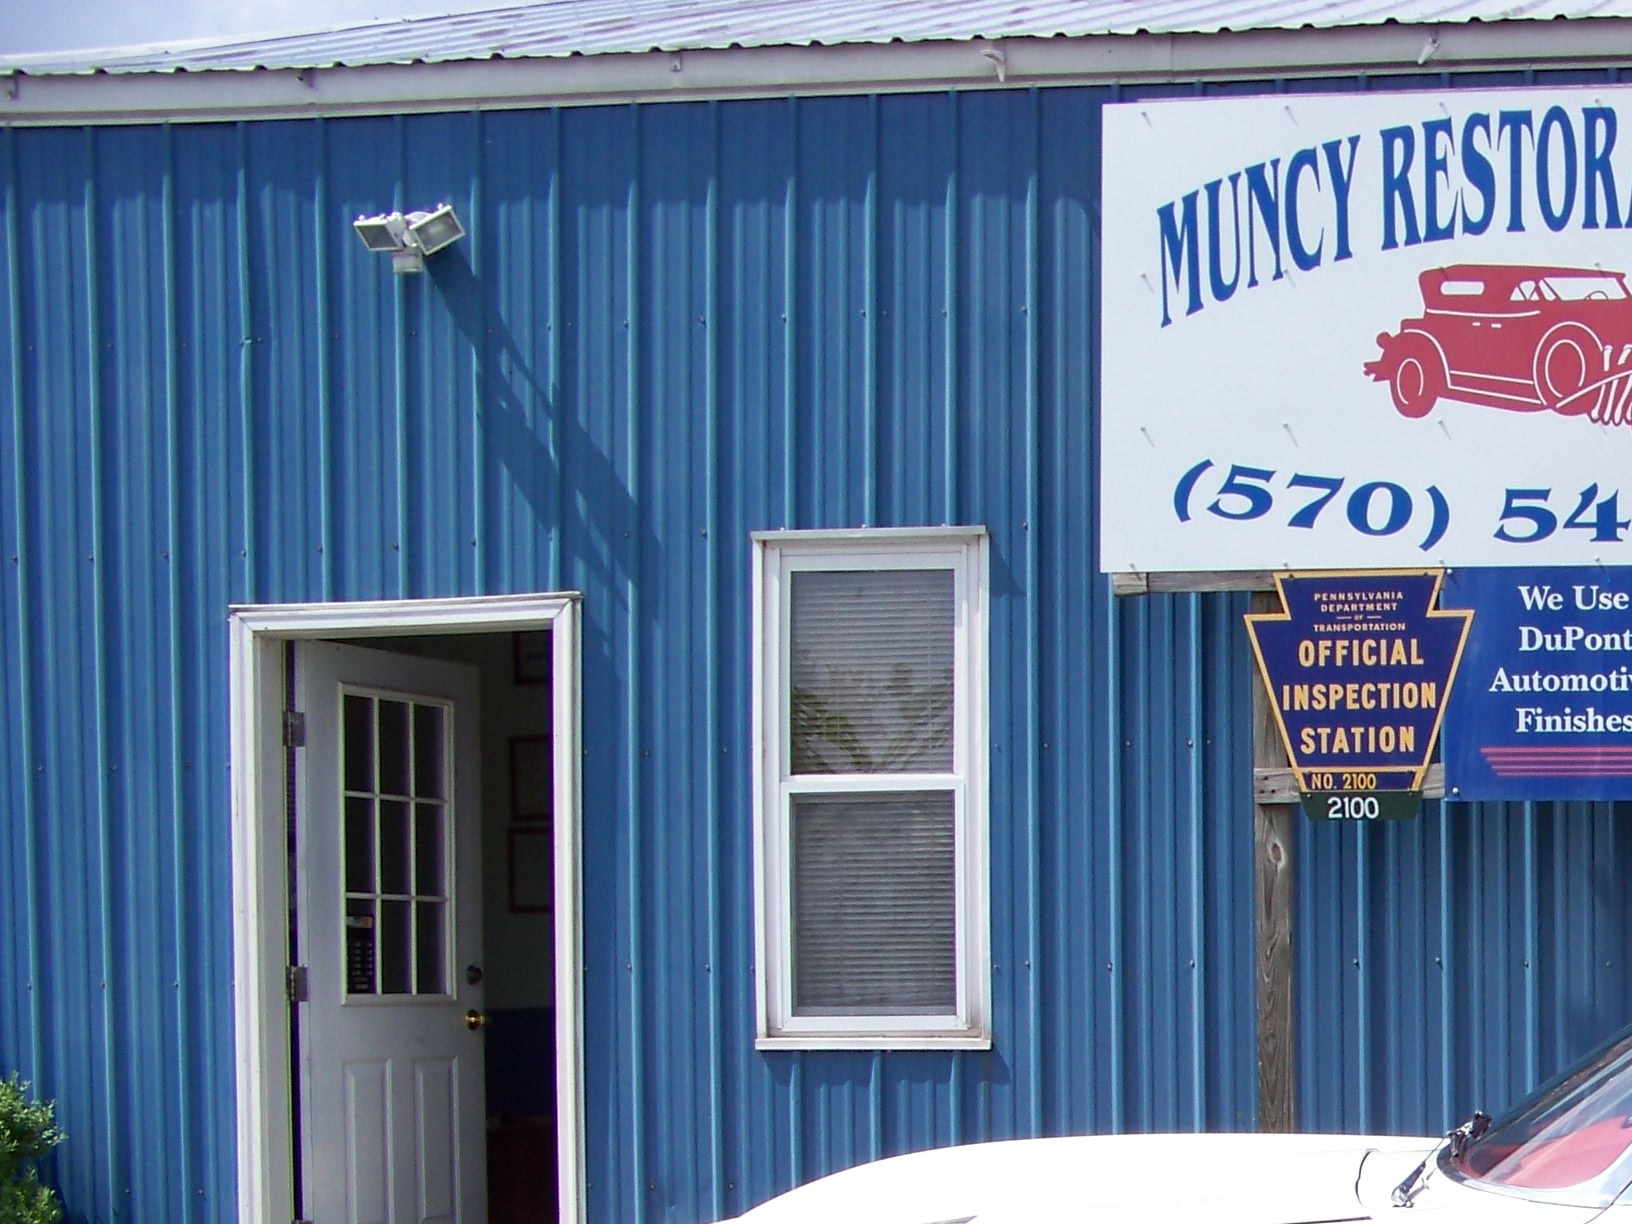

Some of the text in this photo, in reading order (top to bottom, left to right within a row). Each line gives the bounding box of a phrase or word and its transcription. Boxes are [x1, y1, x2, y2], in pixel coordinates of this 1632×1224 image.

[1155, 133, 1361, 328] MUNCY
[1172, 459, 1450, 551] (570)
[1313, 591, 1404, 601] PENNSYLVANIA
[1320, 602, 1398, 612] DEPARTMENT
[1517, 585, 1630, 611] We Use
[1313, 622, 1406, 632] TRANSPORTATION
[1298, 638, 1424, 667] OFFICIAL
[1282, 682, 1436, 711] INSPECTION
[1300, 725, 1415, 755] STATION
[1311, 772, 1377, 790] NO. 2100
[1327, 796, 1380, 819] 2100
